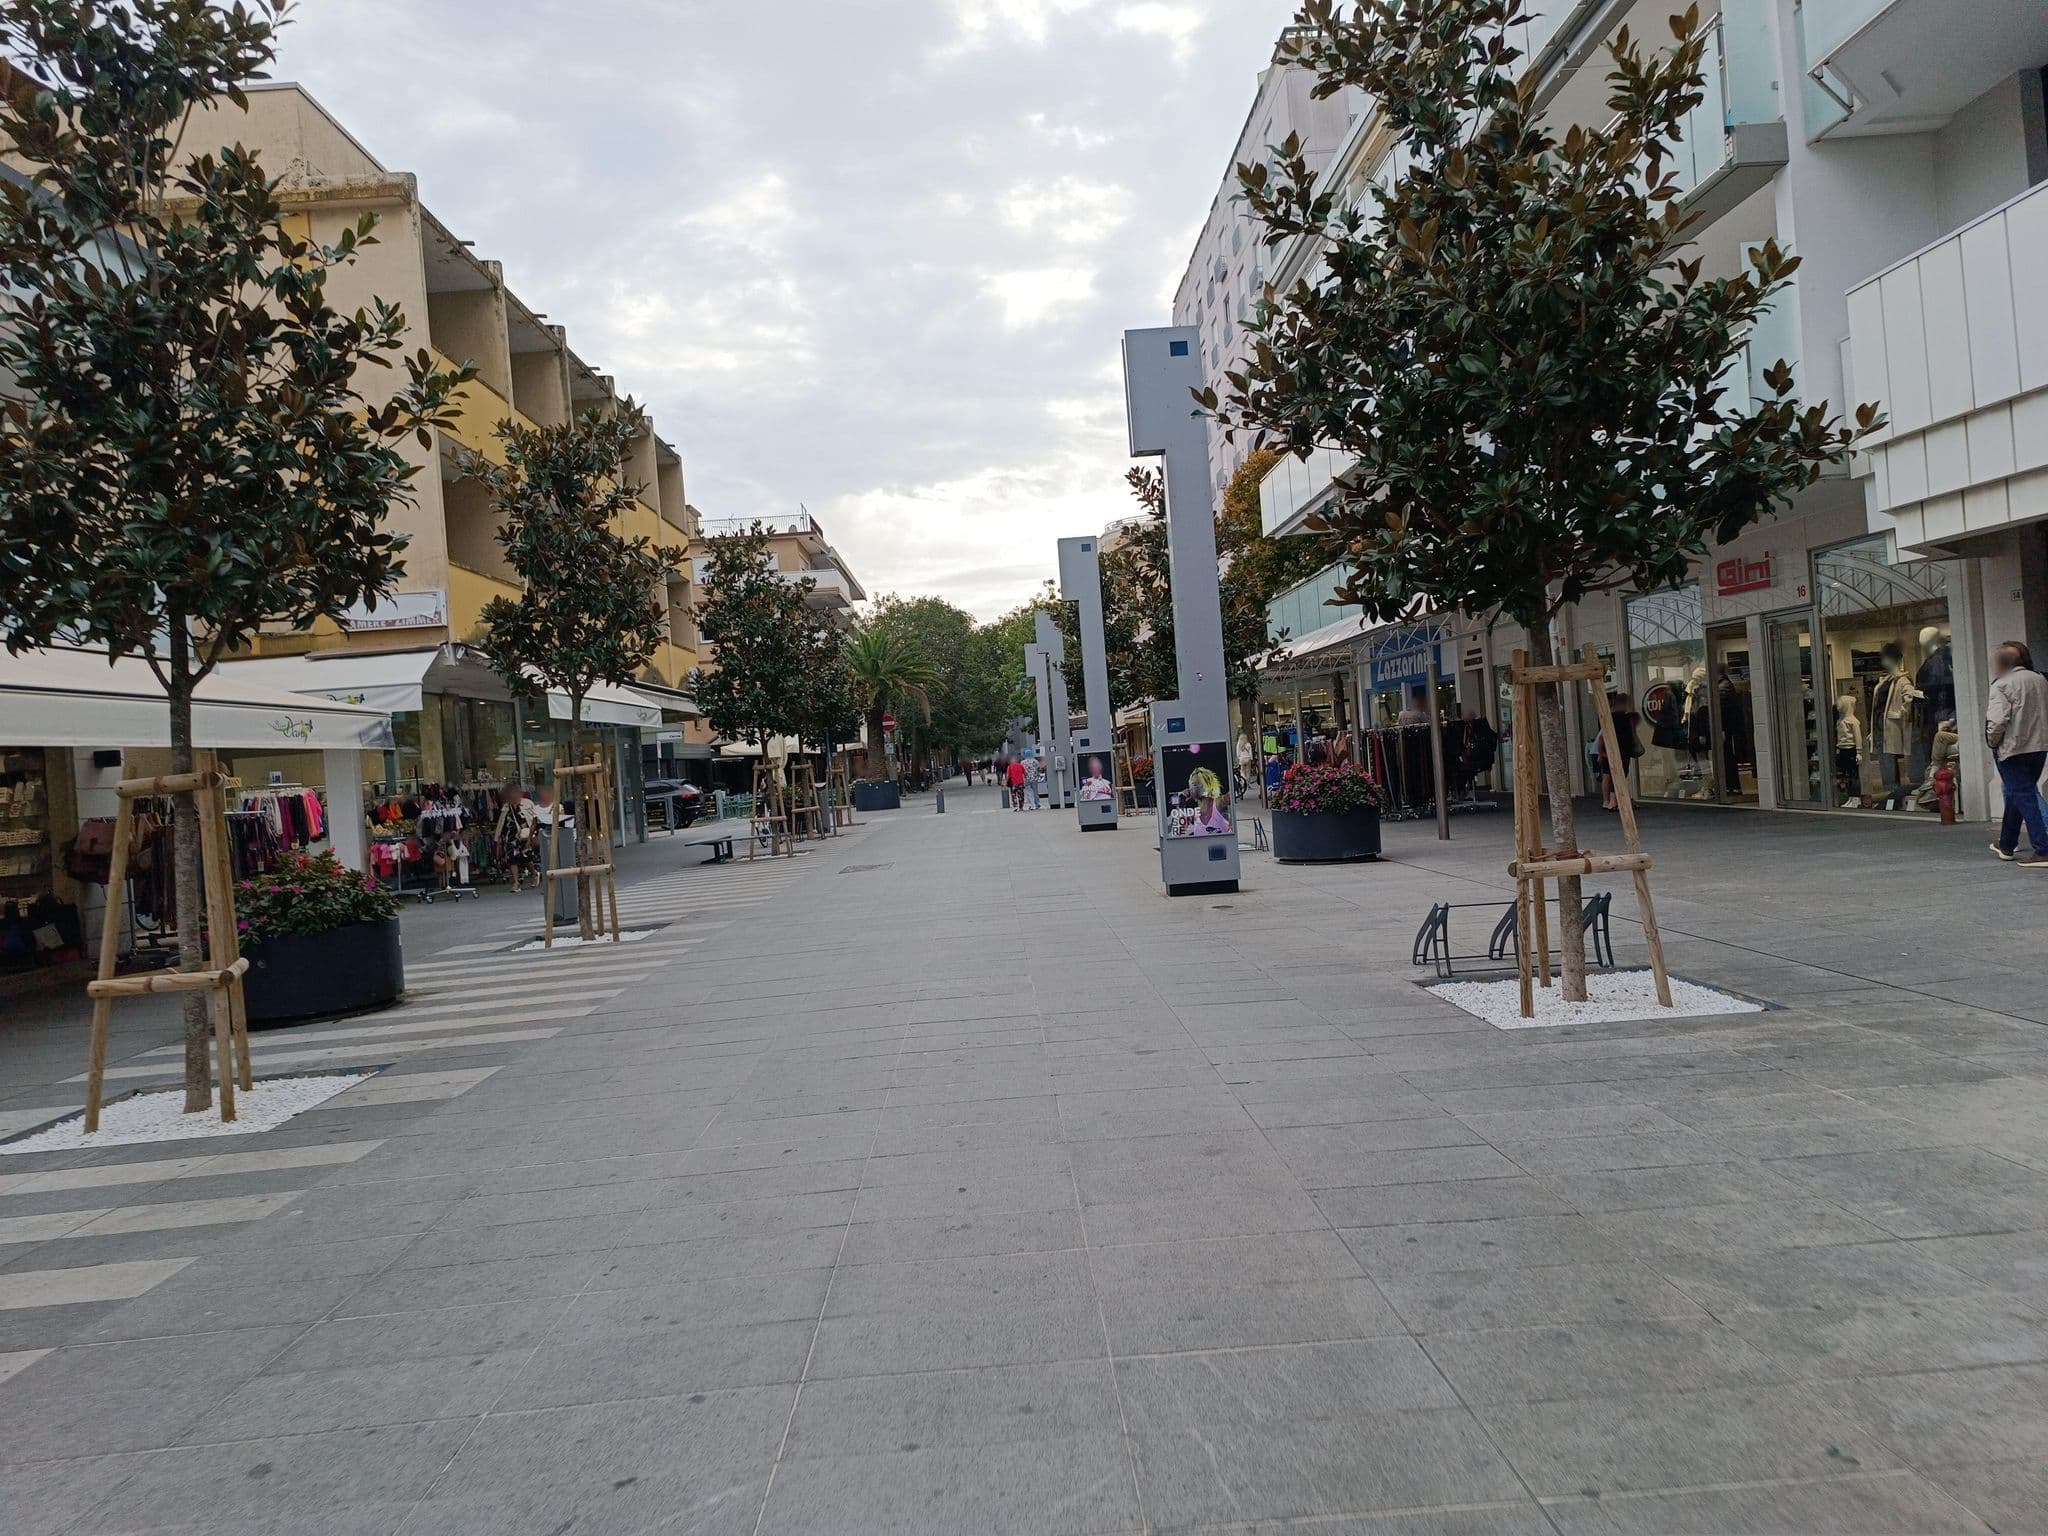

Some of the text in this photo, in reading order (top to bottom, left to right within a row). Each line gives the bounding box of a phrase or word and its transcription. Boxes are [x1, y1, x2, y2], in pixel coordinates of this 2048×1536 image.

[1717, 551, 1771, 587] Gini
[1796, 585, 1806, 597] 16
[1171, 807, 1202, 818] ONDE
